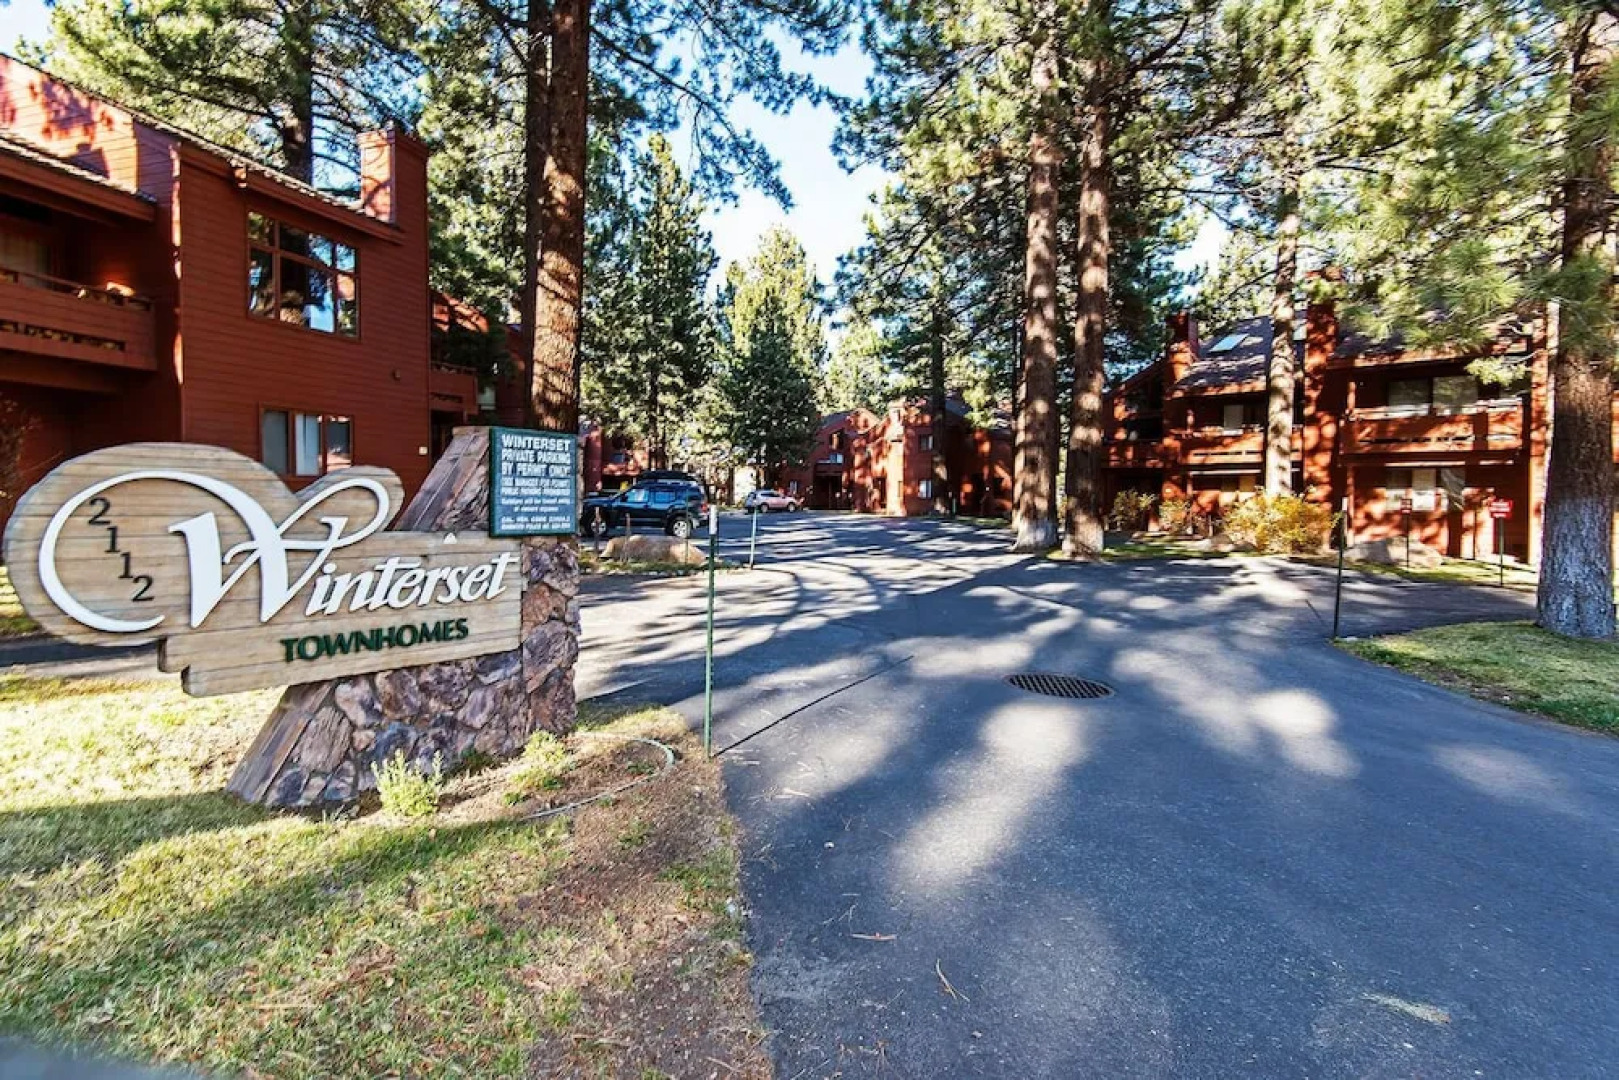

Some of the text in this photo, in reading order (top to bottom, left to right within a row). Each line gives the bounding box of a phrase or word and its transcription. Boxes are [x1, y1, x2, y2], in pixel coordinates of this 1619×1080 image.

[502, 434, 570, 451] WINTERSET
[502, 449, 570, 465] PRIVATE PARKING
[502, 462, 513, 475] BY
[516, 463, 547, 476] PERMIT
[38, 470, 520, 632] Winterset
[88, 496, 155, 602] 2112
[280, 617, 469, 663] TOWNHOMES
